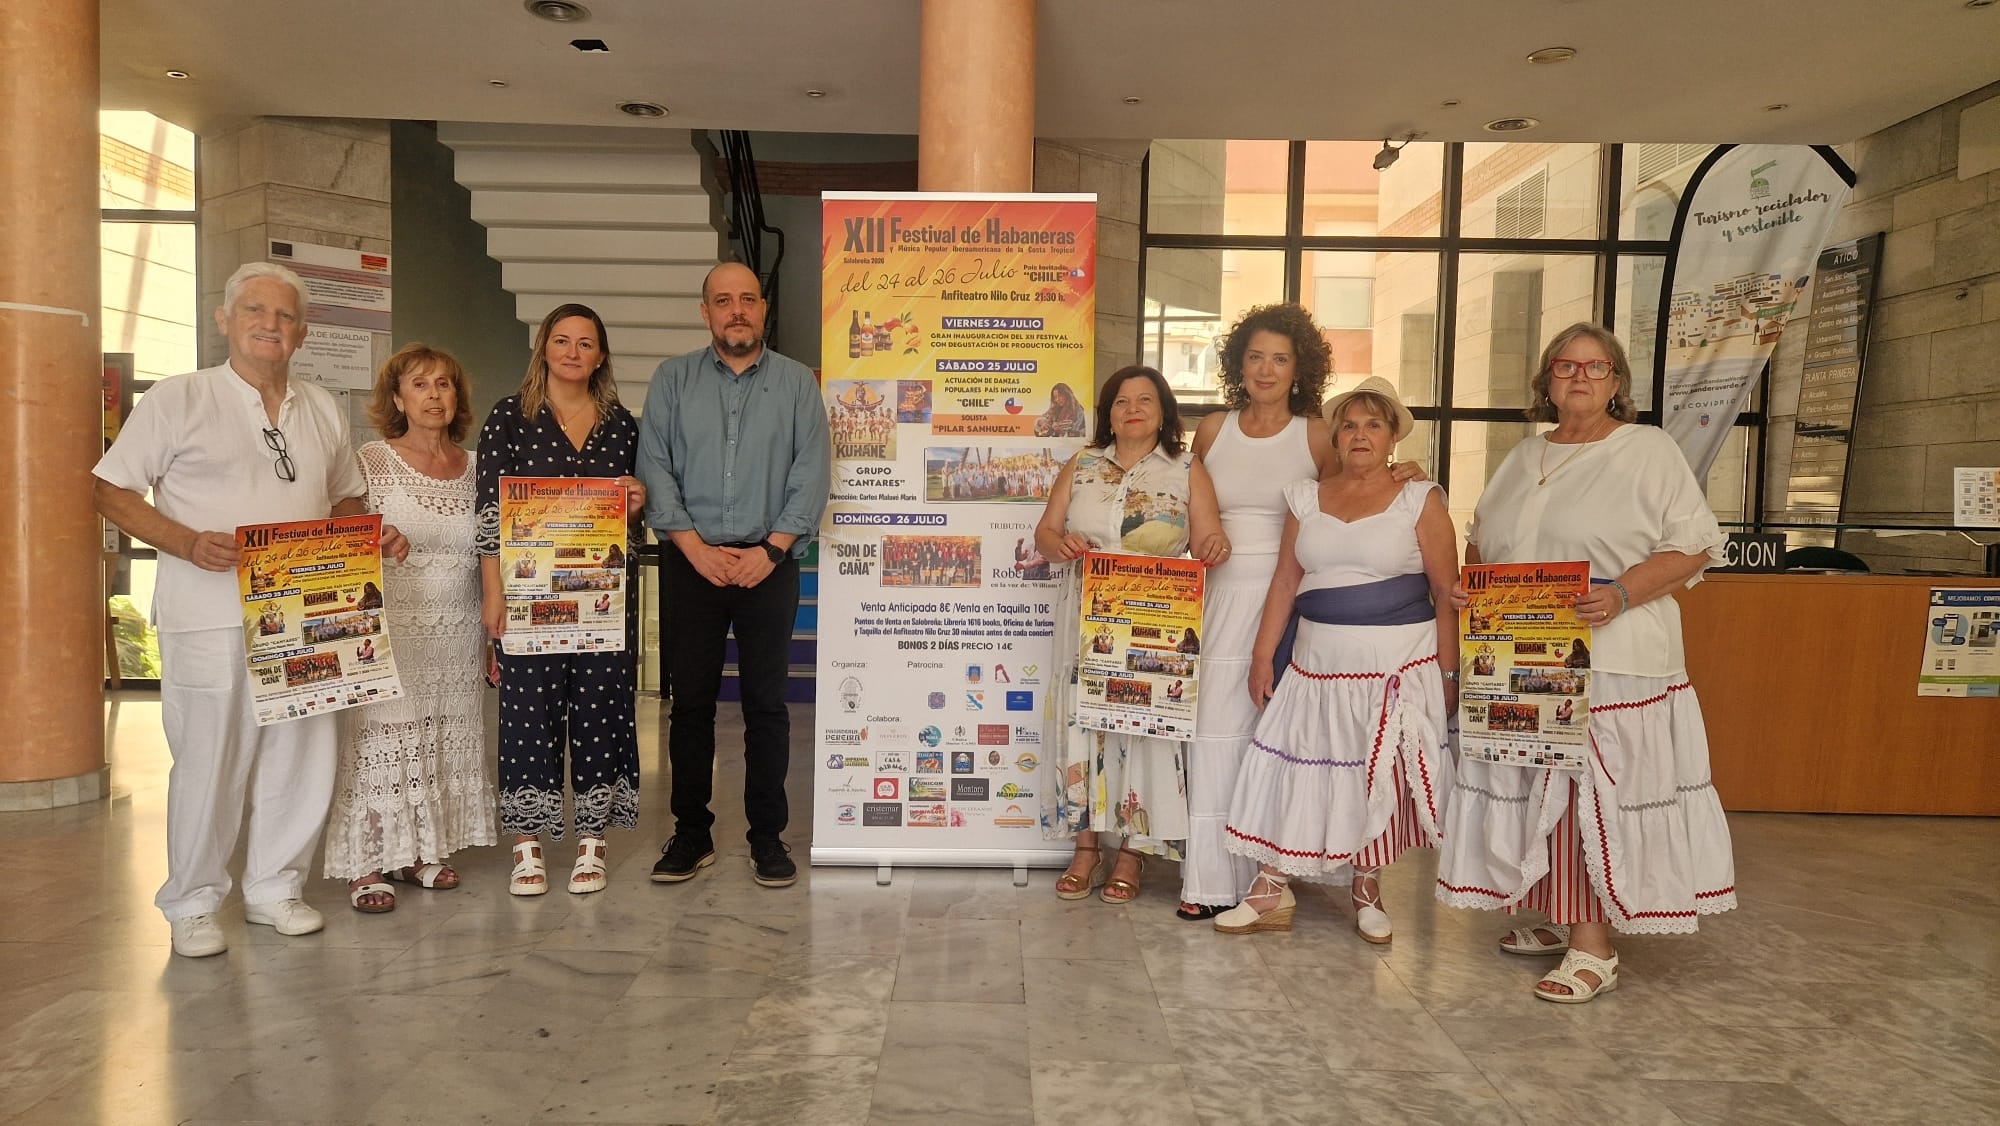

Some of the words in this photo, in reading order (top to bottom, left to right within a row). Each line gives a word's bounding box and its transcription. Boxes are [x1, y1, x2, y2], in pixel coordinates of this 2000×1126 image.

[1694, 208, 1751, 226] Turismo
[1756, 189, 1831, 216] reciclador
[1723, 230, 1733, 242] y
[1737, 210, 1804, 236] sostenible
[844, 217, 885, 253] XII
[891, 217, 956, 243] Festival
[961, 226, 980, 244] de
[986, 218, 1075, 245] Habaneras
[925, 245, 948, 253] Popular
[1051, 246, 1075, 255] Tropical
[840, 271, 872, 293] del
[877, 273, 900, 290] 24
[905, 265, 928, 287] al
[933, 268, 957, 285] 26
[961, 259, 1018, 284] Julio
[1024, 272, 1069, 282] "CHILE"
[941, 290, 988, 300] Anfiteatro
[990, 290, 1008, 301] Nilo
[1010, 291, 1030, 301] Cruz
[1035, 292, 1056, 302] 21:30
[945, 318, 990, 328] VIERNES
[993, 319, 1007, 328] 24
[1010, 319, 1042, 329] JULIO
[330, 332, 369, 342] IGUALDAD
[953, 332, 1009, 340] INAUGURACIÓN
[939, 360, 985, 370] SÁBADO
[988, 362, 1001, 371] 25
[1004, 362, 1036, 371] JULIO
[1805, 372, 1827, 383] PLANTA
[1829, 368, 1856, 379] PRIMERA
[957, 399, 994, 408] "CHILE"
[856, 467, 892, 475] GRUPO
[842, 479, 905, 487] "CANTARES"
[508, 483, 529, 501] XII
[531, 483, 563, 496] Festival
[565, 487, 574, 496] de
[577, 483, 619, 497] Habaneras
[836, 515, 891, 524] DOMINGO
[897, 516, 910, 524] 26
[913, 516, 945, 524] JULIO
[245, 529, 268, 548] XII
[272, 528, 309, 540] Festival
[312, 528, 323, 537] de
[326, 523, 374, 535] Habaneras
[243, 556, 261, 569] del
[280, 548, 292, 561] al
[312, 540, 343, 556] Julio
[831, 544, 859, 557] "SON
[863, 544, 877, 557] DE
[1727, 541, 1777, 567] CION
[290, 566, 316, 574] VIERNES
[839, 559, 875, 576] CAÑA"
[1091, 558, 1110, 576] XII
[1112, 560, 1142, 574] Festival
[1144, 566, 1153, 575] de
[1156, 563, 1198, 579] Habaneras
[1468, 571, 1487, 590] XII
[1489, 571, 1521, 584] Festival
[1523, 574, 1533, 584] de
[1536, 569, 1582, 583] Habaneras
[1089, 581, 1104, 592] del
[1144, 579, 1170, 592] Julio
[283, 588, 301, 597] JULIO
[1465, 598, 1481, 609] del
[1495, 595, 1505, 606] al
[1522, 589, 1551, 603] Julio
[861, 602, 886, 612] Venta
[888, 603, 937, 614] Anticipada
[940, 603, 951, 612] 8€
[997, 604, 1030, 615] Taquilla
[1034, 604, 1050, 614] 10€
[855, 617, 875, 625] Puntos
[1003, 619, 1024, 627] Oficina
[1026, 619, 1032, 627] de
[860, 628, 881, 637] Taquilla
[894, 628, 924, 636] Anfiteatro
[925, 628, 936, 636] Nilo
[938, 628, 951, 636] Cruz
[1029, 629, 1054, 637] conciert
[898, 641, 928, 650] BONOS
[931, 641, 936, 650] 2
[939, 639, 960, 650] DÍAS
[253, 653, 285, 663] DOMINGO
[957, 784, 984, 793] Montoro
